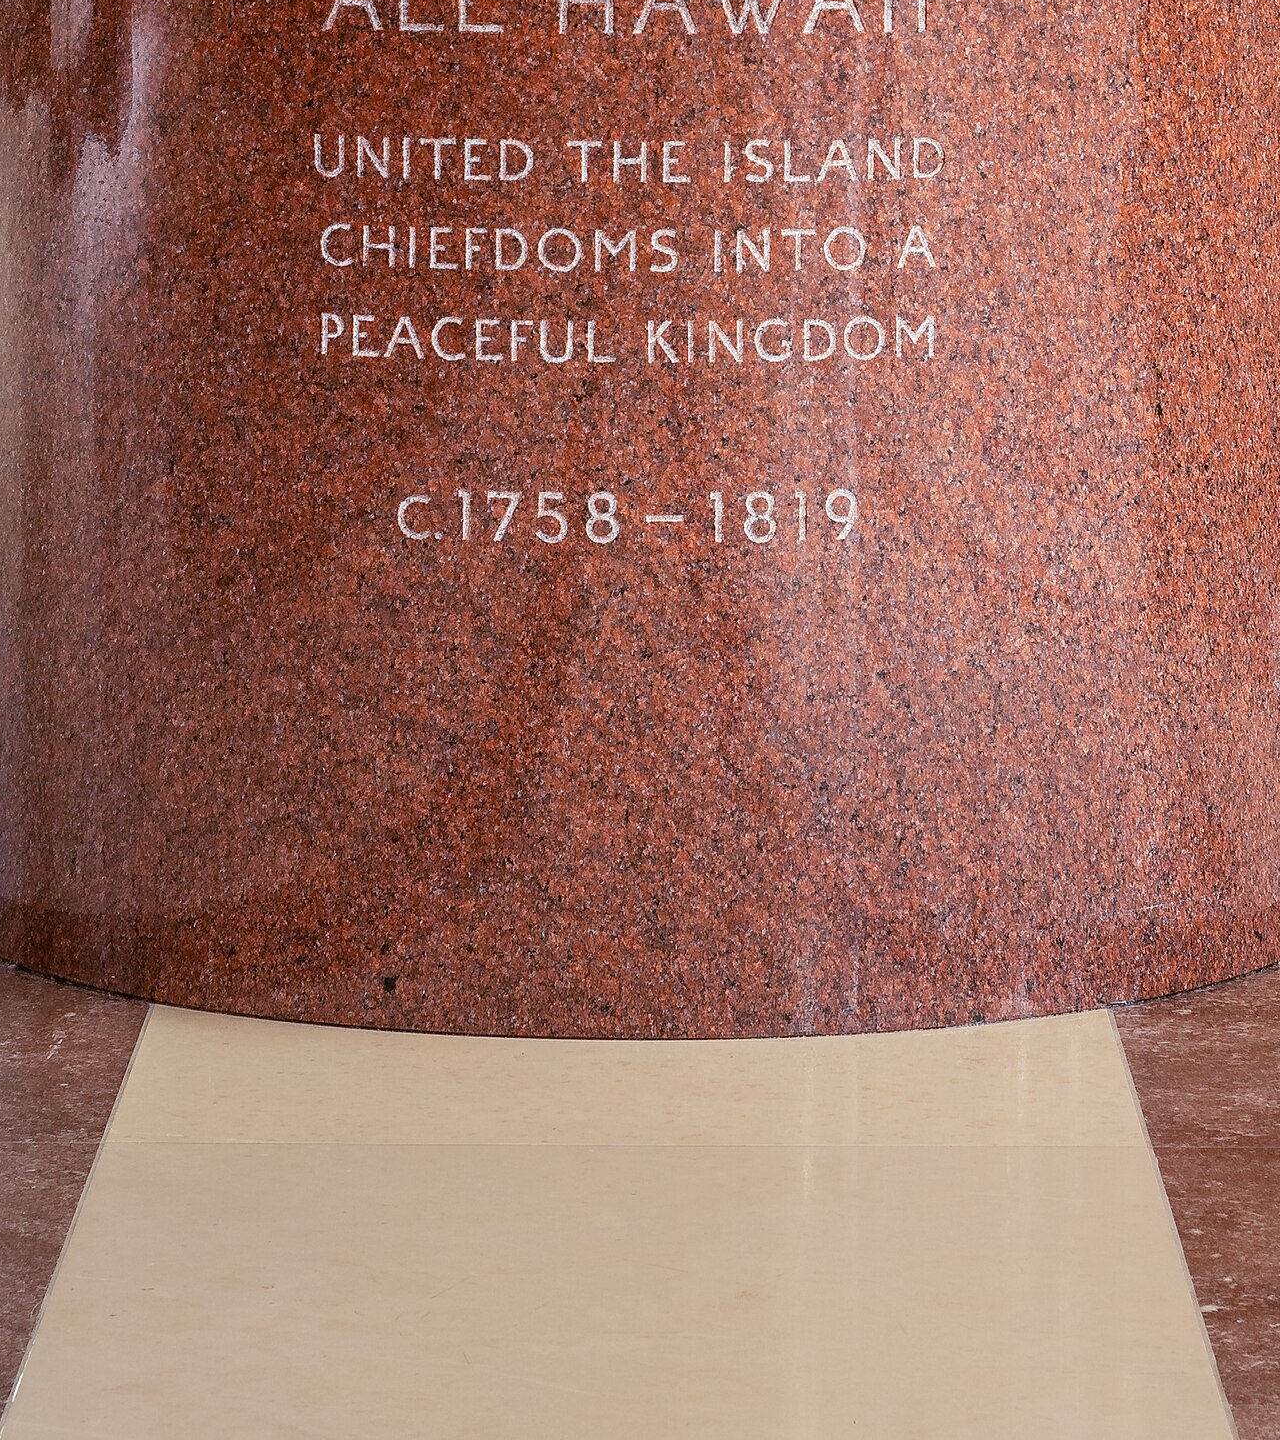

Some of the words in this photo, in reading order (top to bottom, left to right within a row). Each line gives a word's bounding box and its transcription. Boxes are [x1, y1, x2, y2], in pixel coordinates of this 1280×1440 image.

[313, 133, 535, 182] UNITED
[567, 139, 691, 183] THE
[723, 137, 946, 182] ISLAND
[319, 223, 679, 273] CHIEFDOMS
[713, 225, 867, 273] INTO
[896, 226, 937, 270] A
[319, 313, 617, 364] PEACEFUL
[646, 315, 936, 364] KINGDOM
